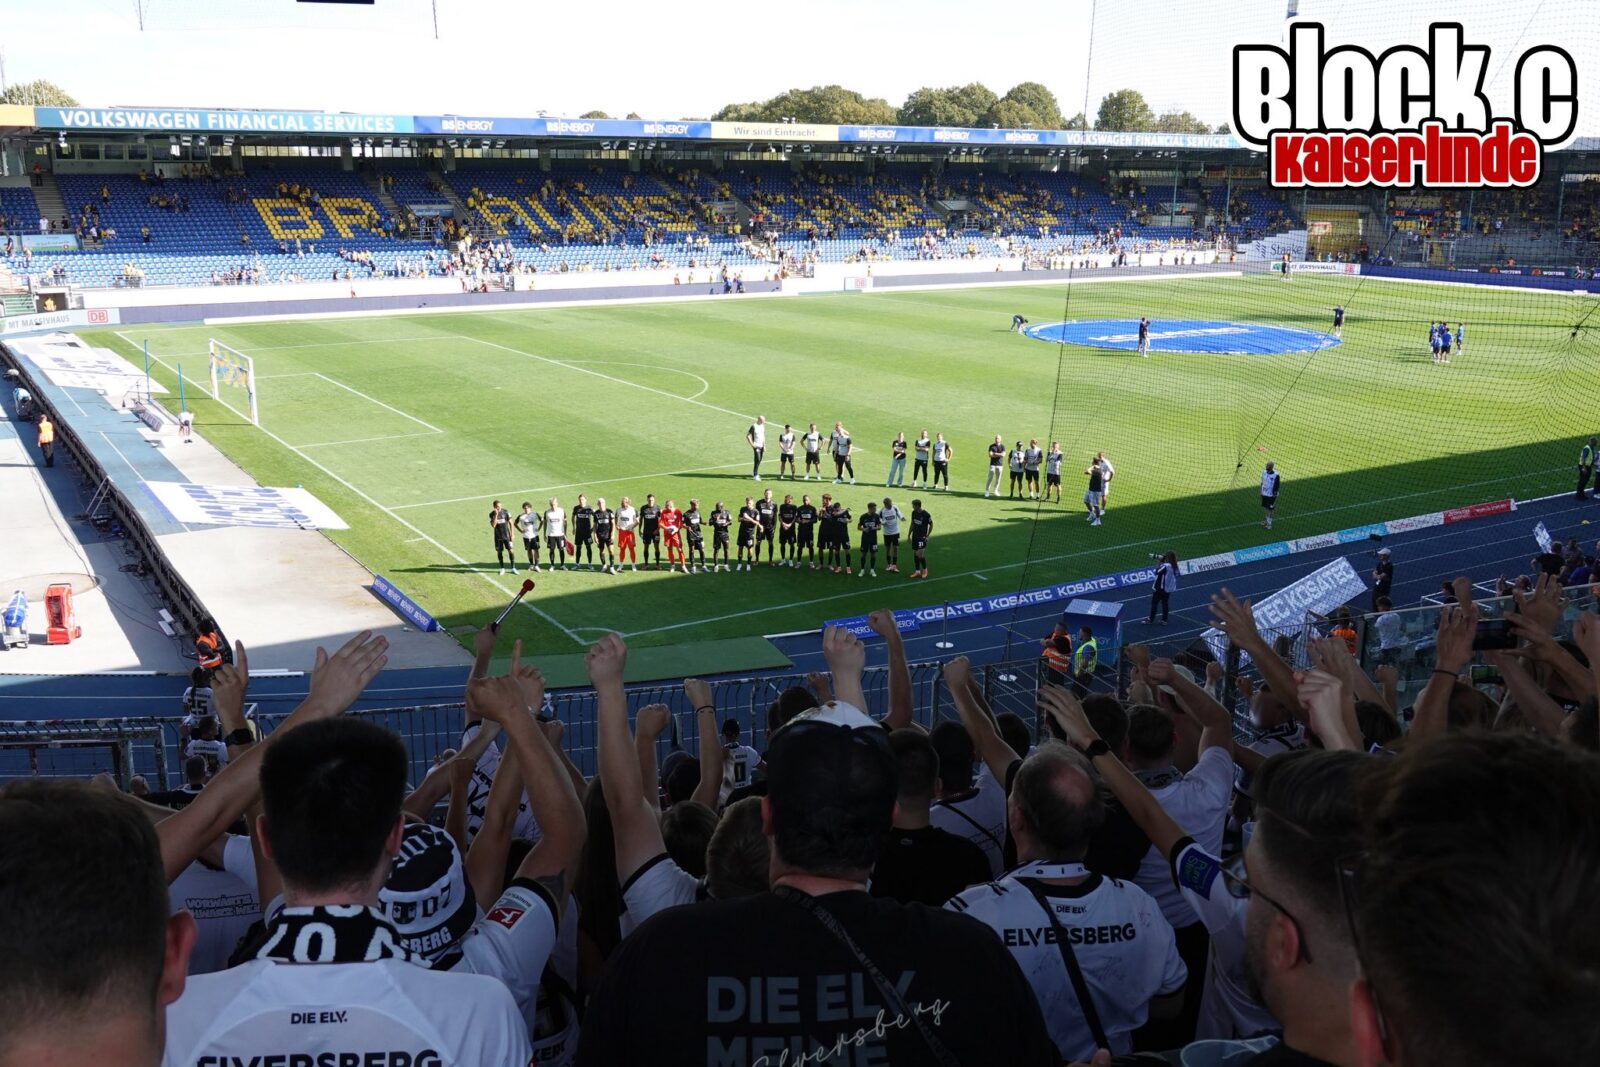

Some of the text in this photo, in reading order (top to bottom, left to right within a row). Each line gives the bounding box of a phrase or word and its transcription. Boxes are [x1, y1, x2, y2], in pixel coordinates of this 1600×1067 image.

[59, 110, 395, 132] VOLKSWAGEN FINANCIAL SERVICES
[733, 126, 749, 136] Wir
[752, 127, 772, 136] sind
[1066, 133, 1230, 147] VOLKSWAGEN FINANCIAL SERVICES
[89, 311, 107, 322] DB
[1286, 562, 1356, 608] KOSATEC
[914, 567, 1157, 622] KOSATEC KOSATEC KOSATEC KOSA
[1056, 905, 1071, 914] DIE
[706, 974, 801, 1024] DIE
[291, 1012, 317, 1025] DIE
